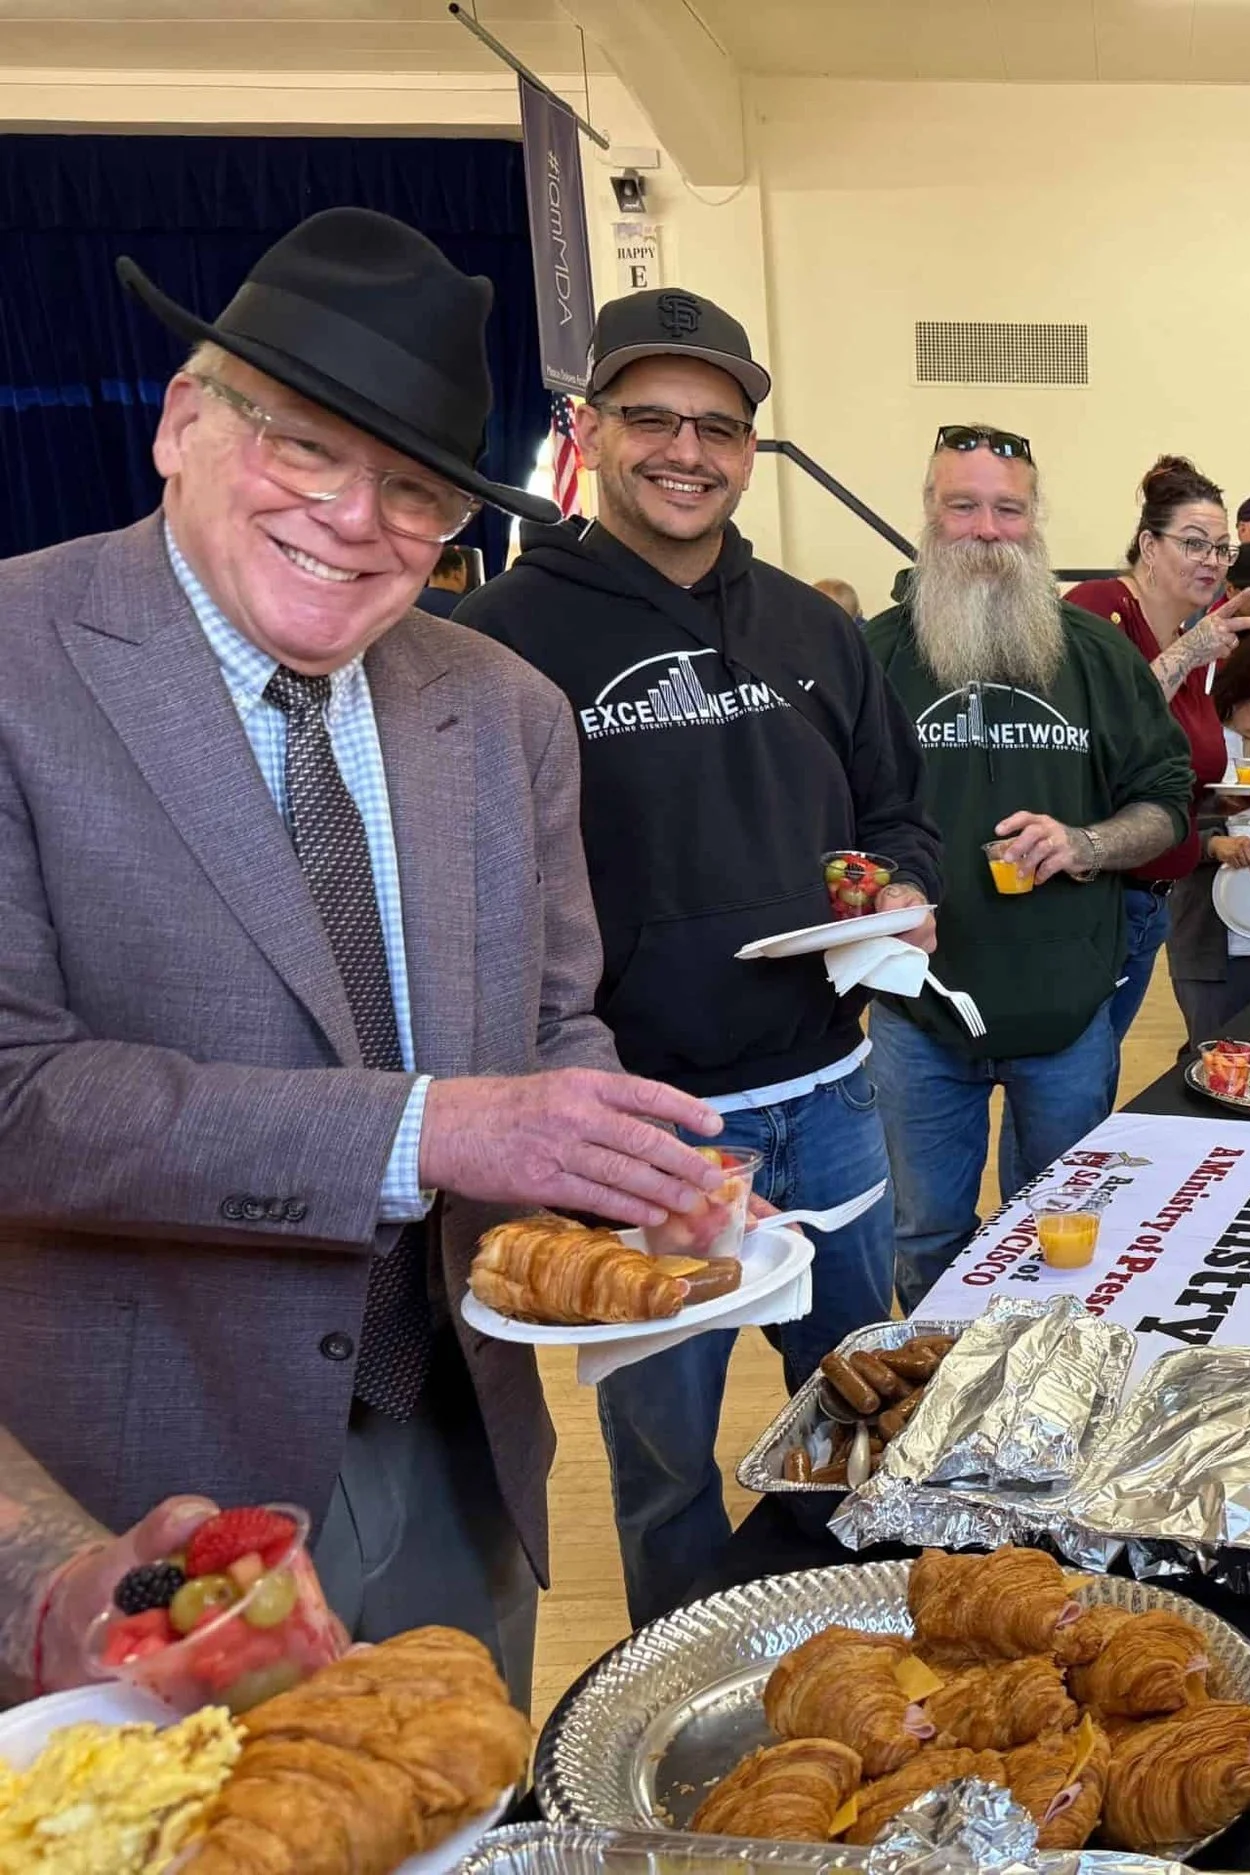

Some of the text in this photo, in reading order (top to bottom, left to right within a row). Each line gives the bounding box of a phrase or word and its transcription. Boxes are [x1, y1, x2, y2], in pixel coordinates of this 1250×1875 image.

[617, 246, 655, 259] HAPPY
[630, 265, 648, 288] E
[987, 723, 1090, 748] NETWORK
[1208, 1146, 1245, 1158] A
[1139, 1159, 1235, 1234] Ministry
[1126, 1234, 1164, 1255] of
[1008, 1263, 1041, 1282] of
[1085, 1255, 1158, 1317] Pres
